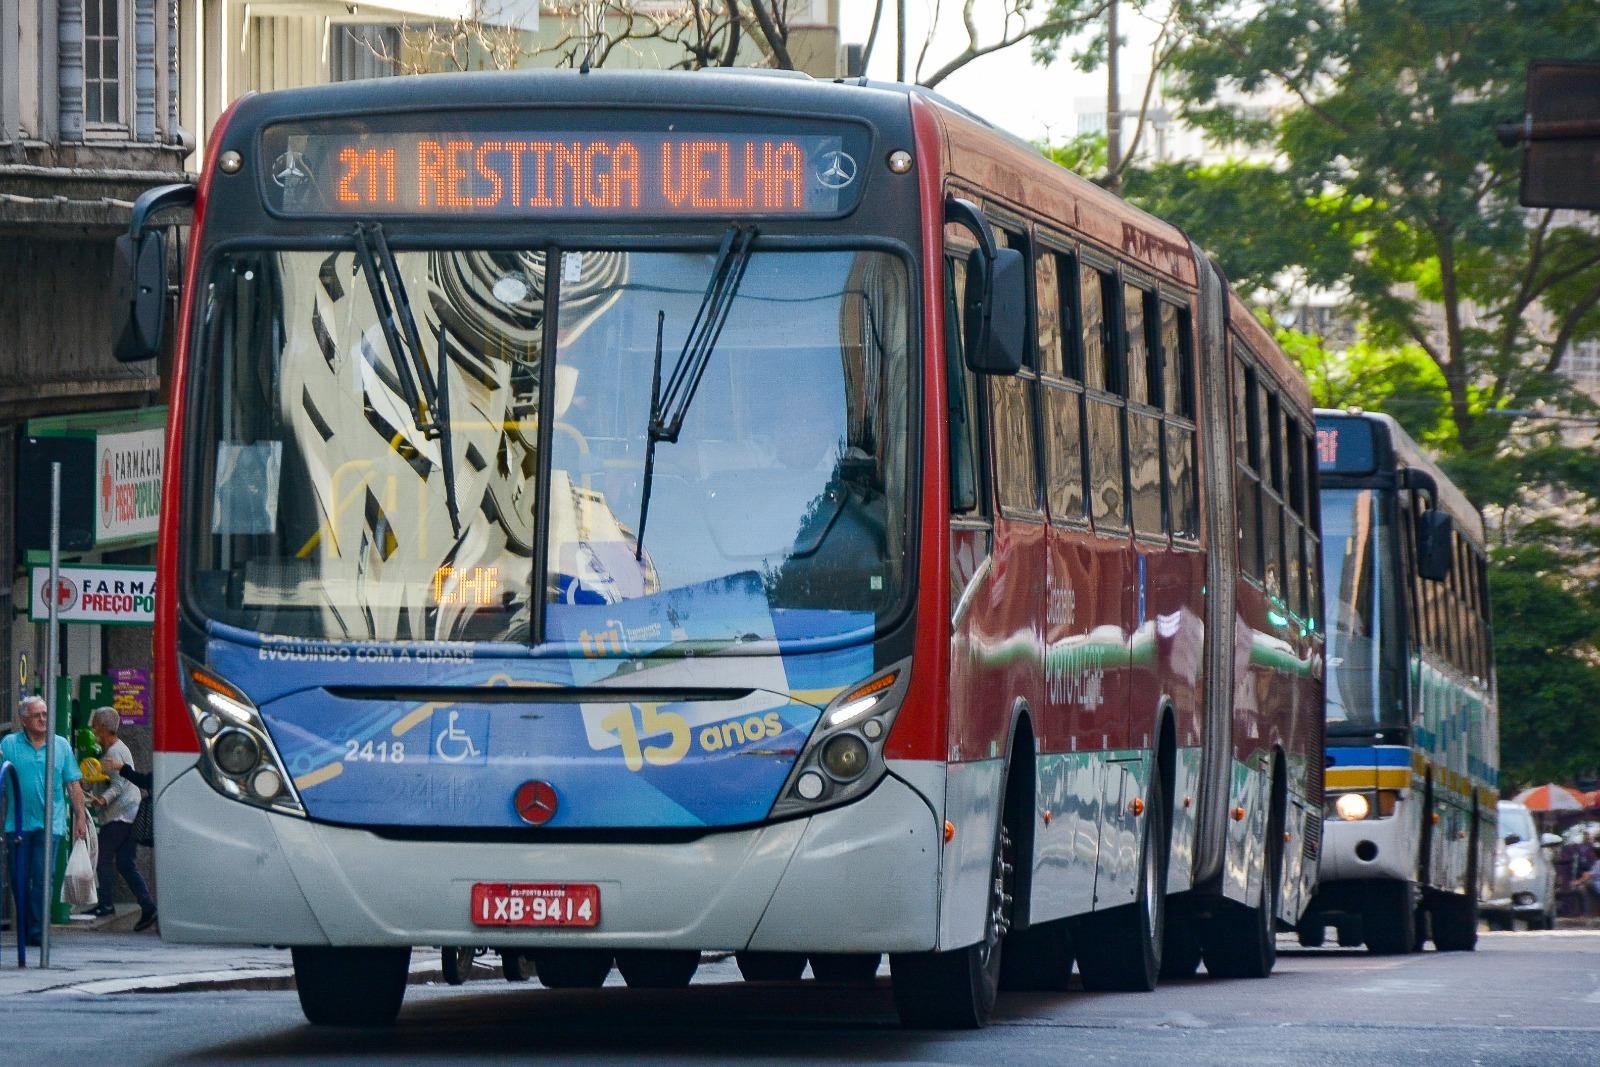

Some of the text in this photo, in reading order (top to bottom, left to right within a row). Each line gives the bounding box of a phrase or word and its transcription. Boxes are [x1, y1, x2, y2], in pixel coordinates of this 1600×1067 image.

[336, 140, 802, 207] 211 RESTINGA VELHA
[115, 440, 160, 480] FARMÁCIA
[356, 646, 394, 663] COM
[399, 647, 411, 663] A
[577, 619, 621, 659] tri
[344, 739, 405, 763] 2418
[601, 702, 783, 772] 15 anos
